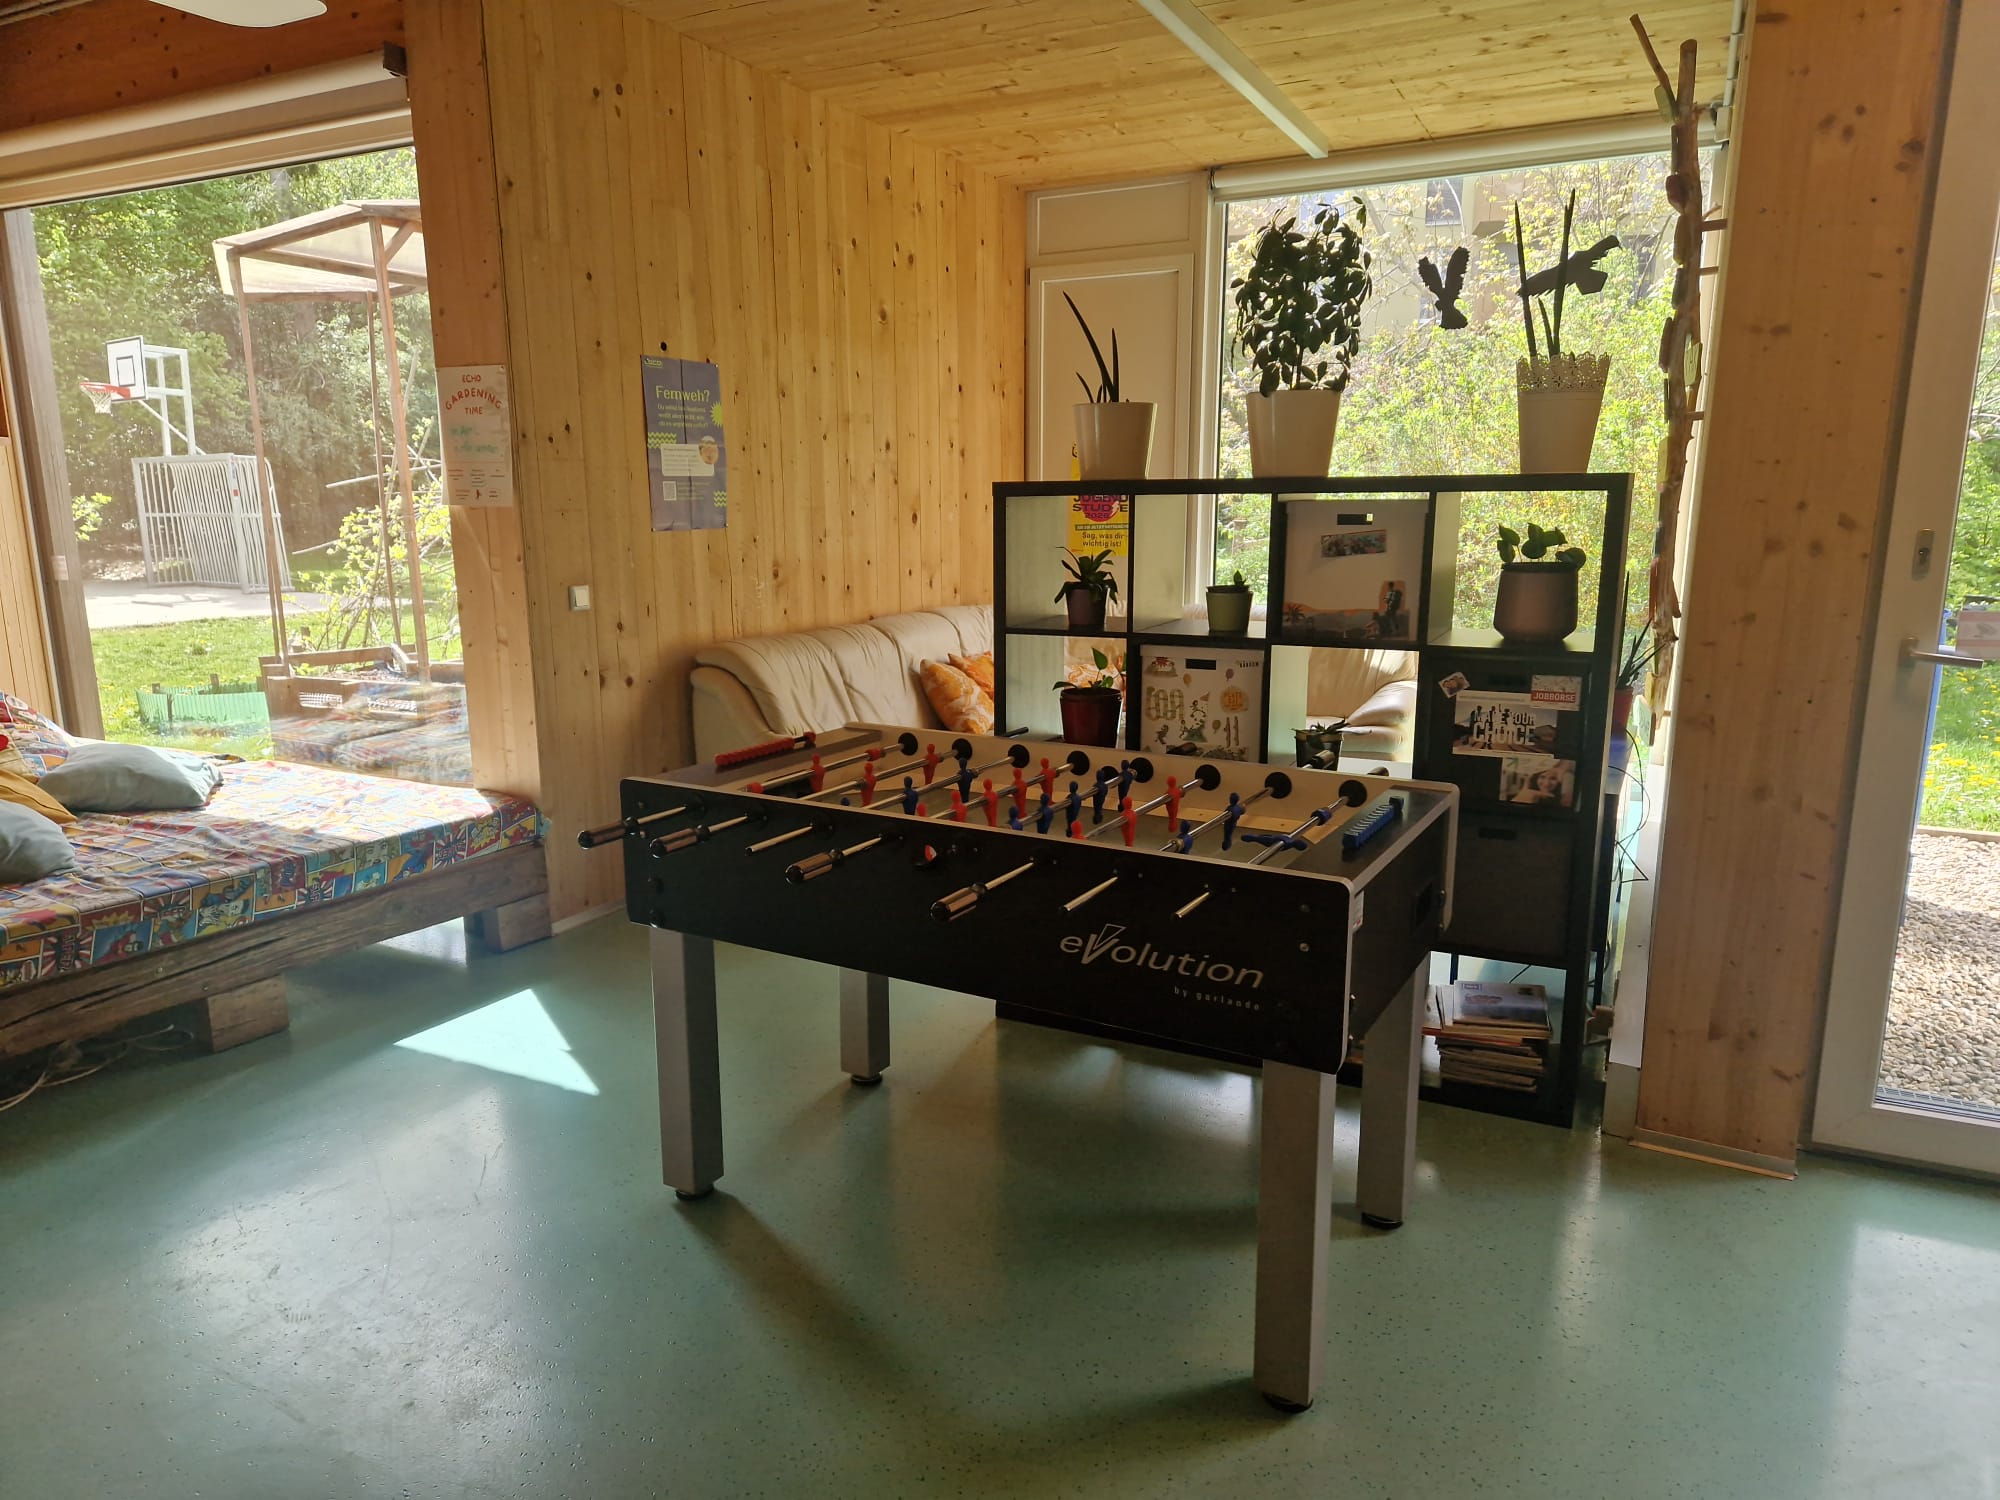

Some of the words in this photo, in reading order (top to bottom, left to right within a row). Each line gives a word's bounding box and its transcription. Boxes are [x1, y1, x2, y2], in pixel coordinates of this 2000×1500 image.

[462, 374, 482, 383] ECHO
[444, 388, 503, 411] GARDENING
[464, 406, 483, 415] TIME
[1082, 532, 1098, 540] Sag,
[1082, 540, 1109, 548] wichtig
[1473, 722, 1536, 746] CHOICE
[1173, 986, 1189, 998] by
[1196, 992, 1260, 1010] garlando
